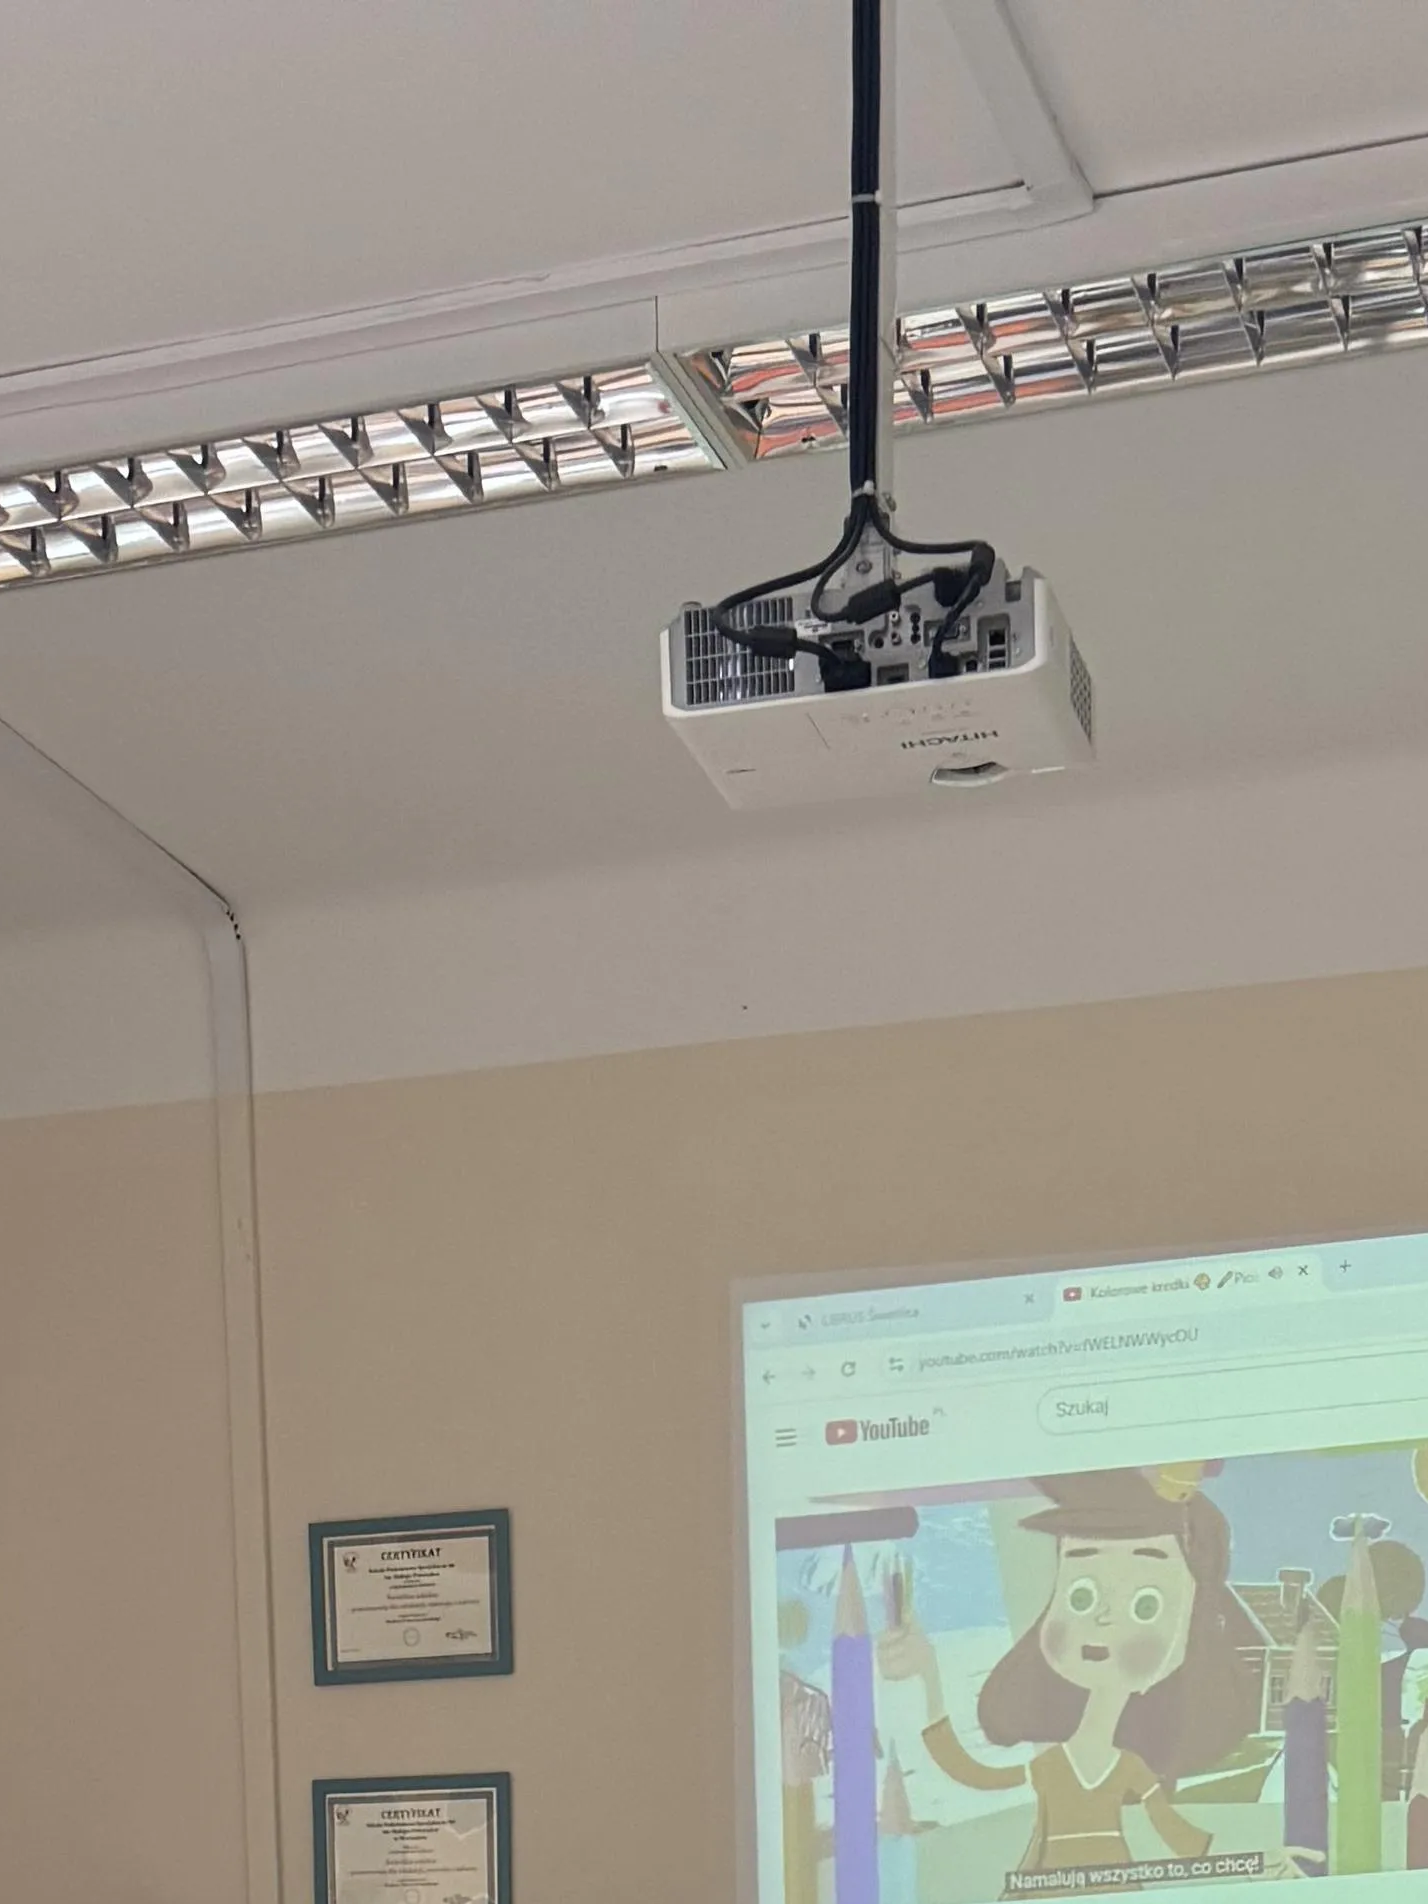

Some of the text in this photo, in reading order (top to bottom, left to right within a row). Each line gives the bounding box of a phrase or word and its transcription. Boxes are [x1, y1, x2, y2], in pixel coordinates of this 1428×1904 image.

[901, 730, 999, 749] HITACHI
[1056, 1396, 1109, 1419] Szukaj
[859, 1415, 930, 1442] YouTube
[381, 1547, 442, 1561] CERTYFIKAT
[380, 1807, 441, 1819] CERTYFIKAT
[1010, 1854, 1262, 1891] Namalują wszystko to, co chcę!
